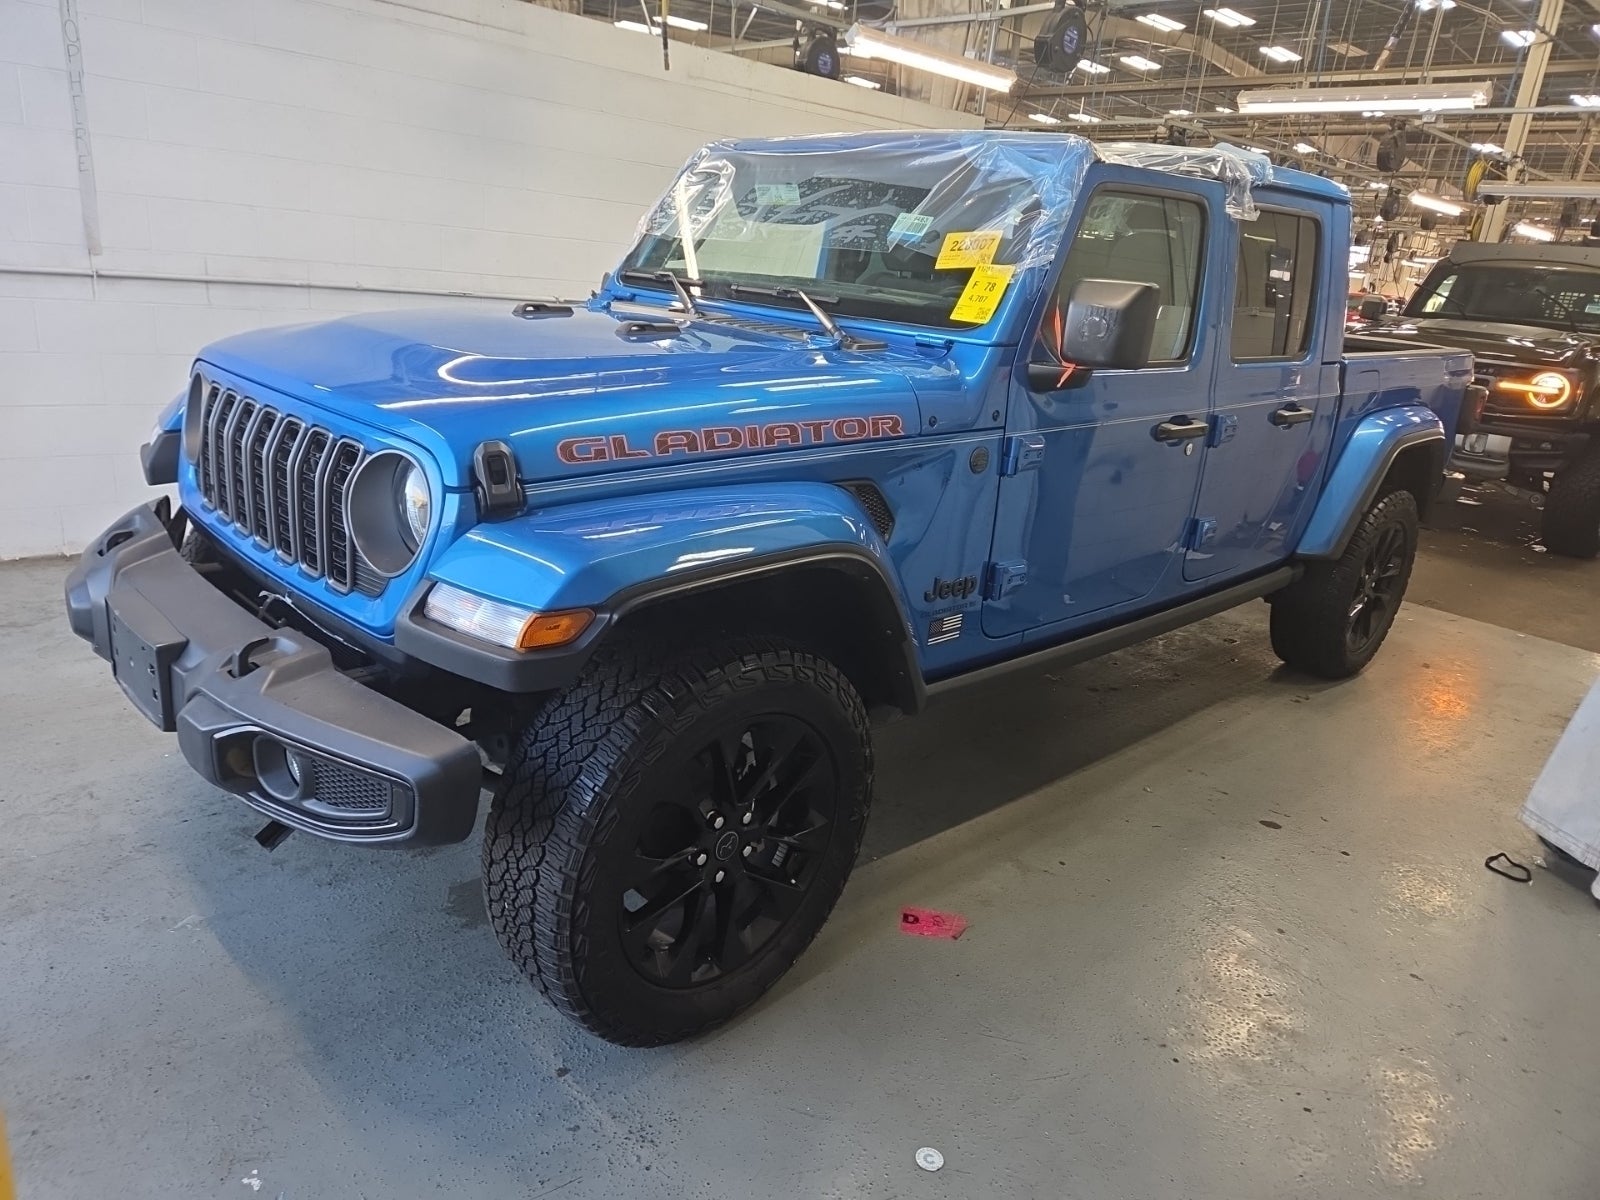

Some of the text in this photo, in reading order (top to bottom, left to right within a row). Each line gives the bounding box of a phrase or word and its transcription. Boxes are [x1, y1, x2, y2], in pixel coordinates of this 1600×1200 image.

[972, 281, 997, 292] F 78
[556, 414, 905, 465] GLADIATOR
[924, 575, 977, 603] Jeep
[903, 913, 919, 925] D
